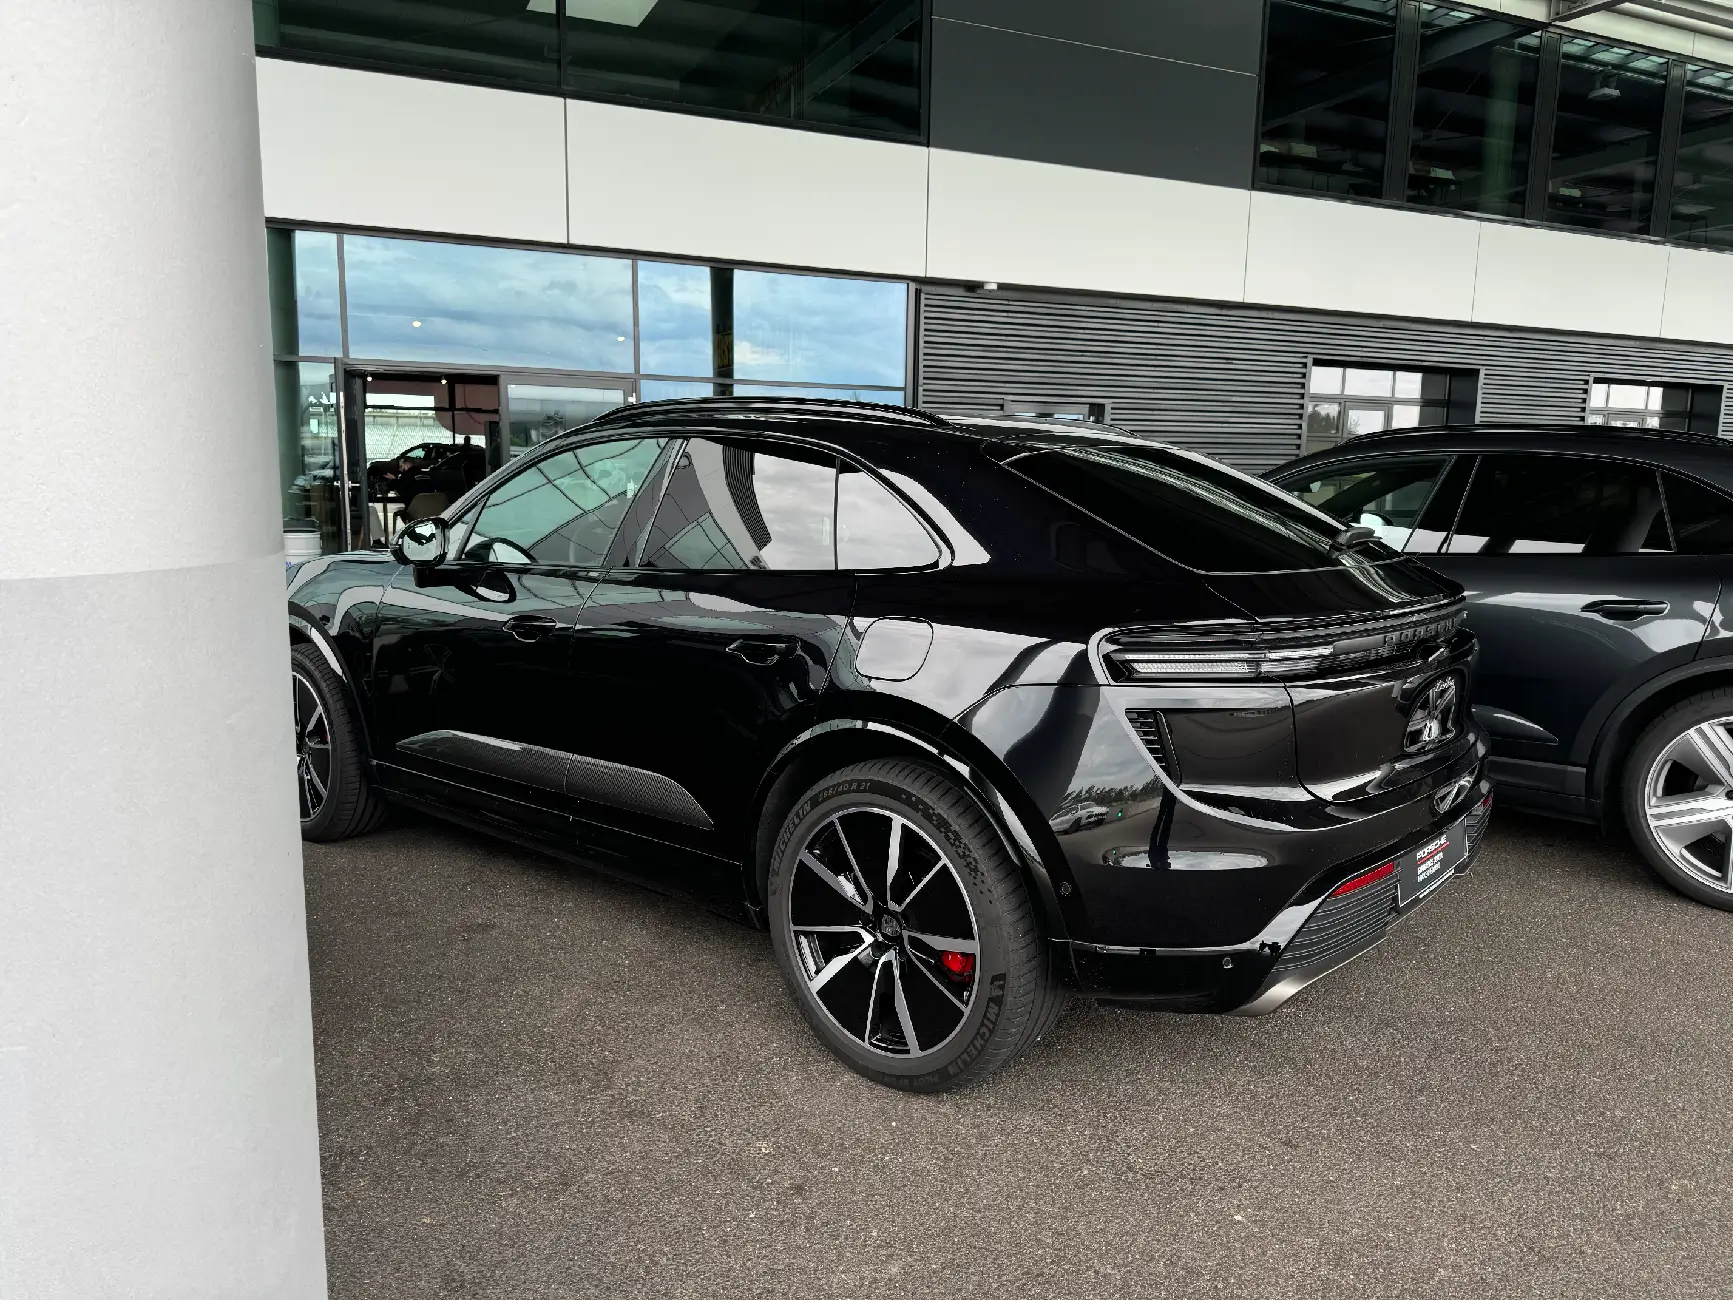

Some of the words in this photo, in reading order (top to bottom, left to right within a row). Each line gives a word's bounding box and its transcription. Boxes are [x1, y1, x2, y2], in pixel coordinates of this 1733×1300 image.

[771, 800, 811, 871] MICHELIN
[1417, 834, 1447, 860] PORSCHE
[947, 1002, 999, 1076] MICHELIN
